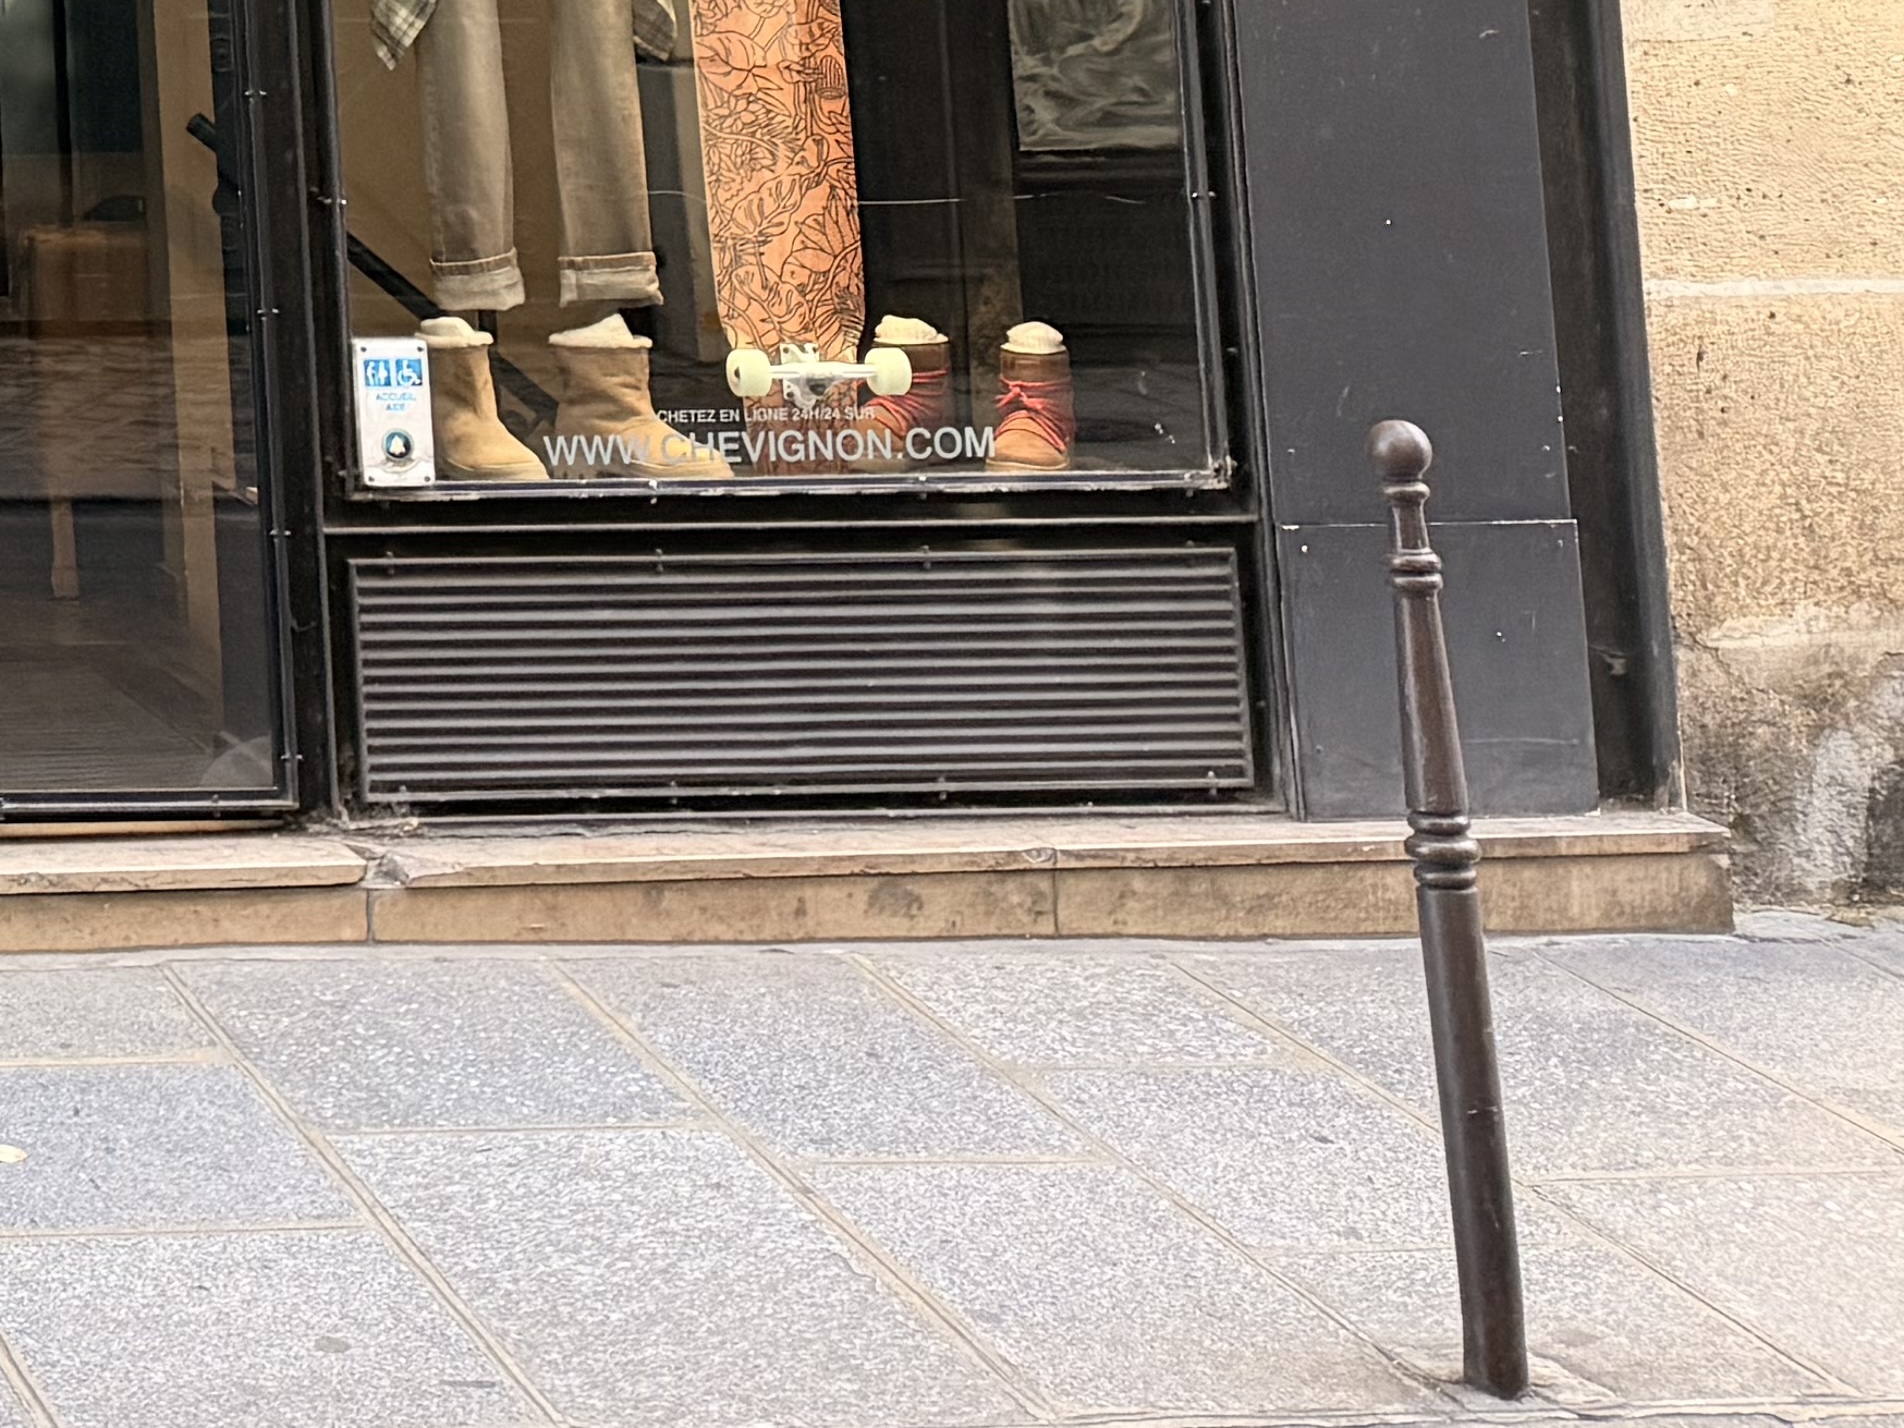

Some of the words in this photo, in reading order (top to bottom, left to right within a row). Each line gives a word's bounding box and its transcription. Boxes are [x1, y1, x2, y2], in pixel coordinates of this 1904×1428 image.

[656, 408, 716, 423] CHETEZ
[719, 408, 740, 422] EN
[744, 407, 788, 421] LIGNE
[844, 406, 876, 420] SUR
[543, 425, 996, 467] WWW.CHEVIGNON.COM
